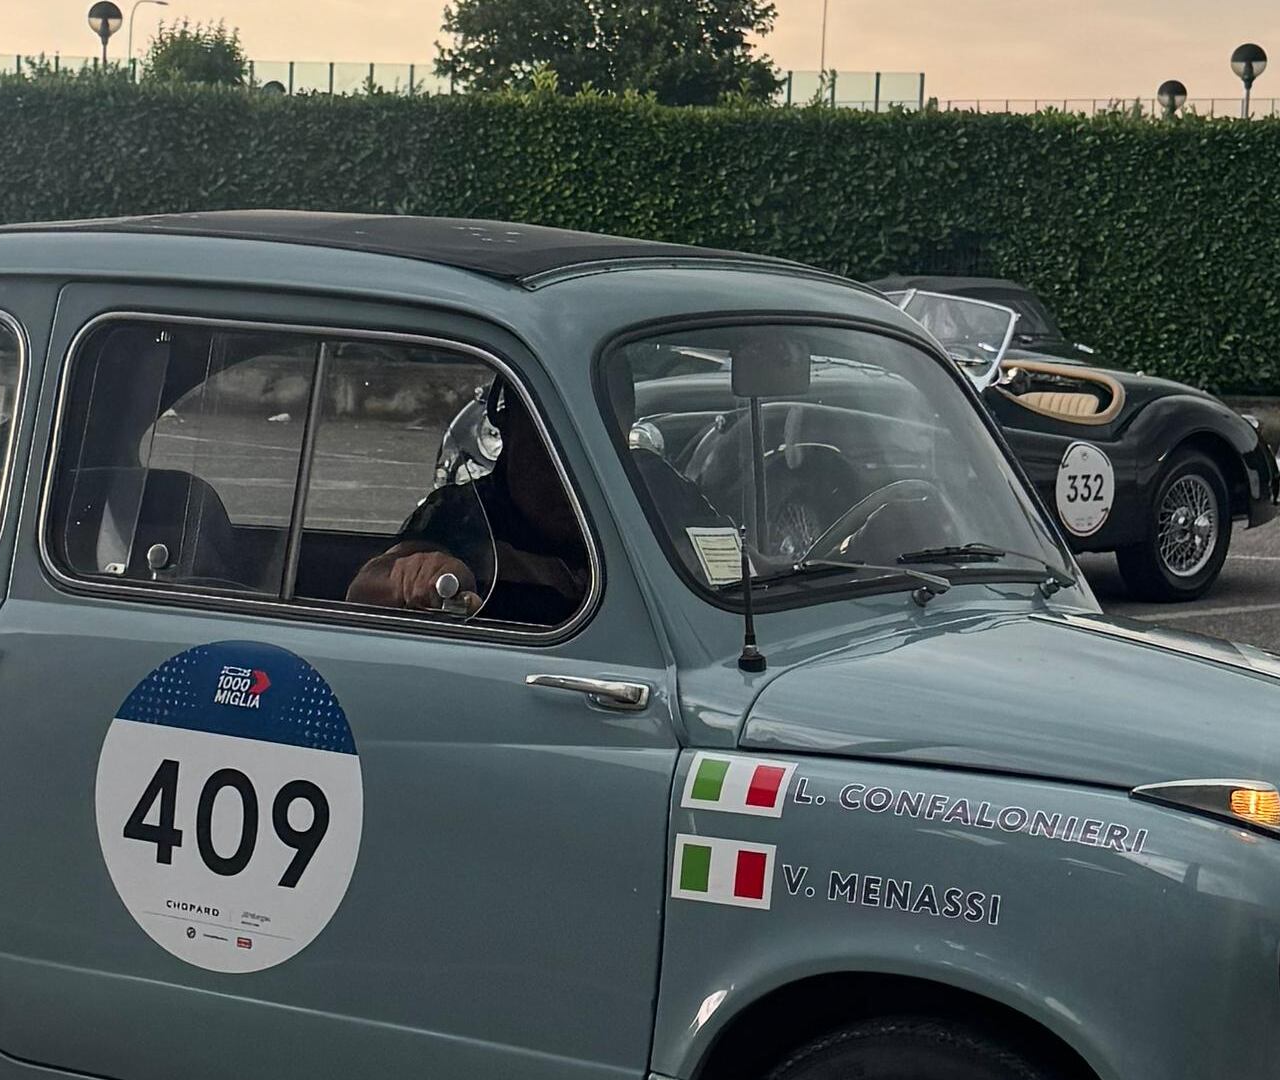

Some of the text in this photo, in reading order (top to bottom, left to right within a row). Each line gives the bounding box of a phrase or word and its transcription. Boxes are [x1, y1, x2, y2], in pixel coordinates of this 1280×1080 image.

[1066, 474, 1104, 502] 332
[218, 675, 251, 692] 1000
[214, 689, 260, 709] MIGLIA
[123, 758, 330, 888] 409
[794, 777, 1148, 854] L. CONFALONIERI
[166, 900, 220, 917] CHOPARD
[782, 864, 1001, 926] V. MENASSI
